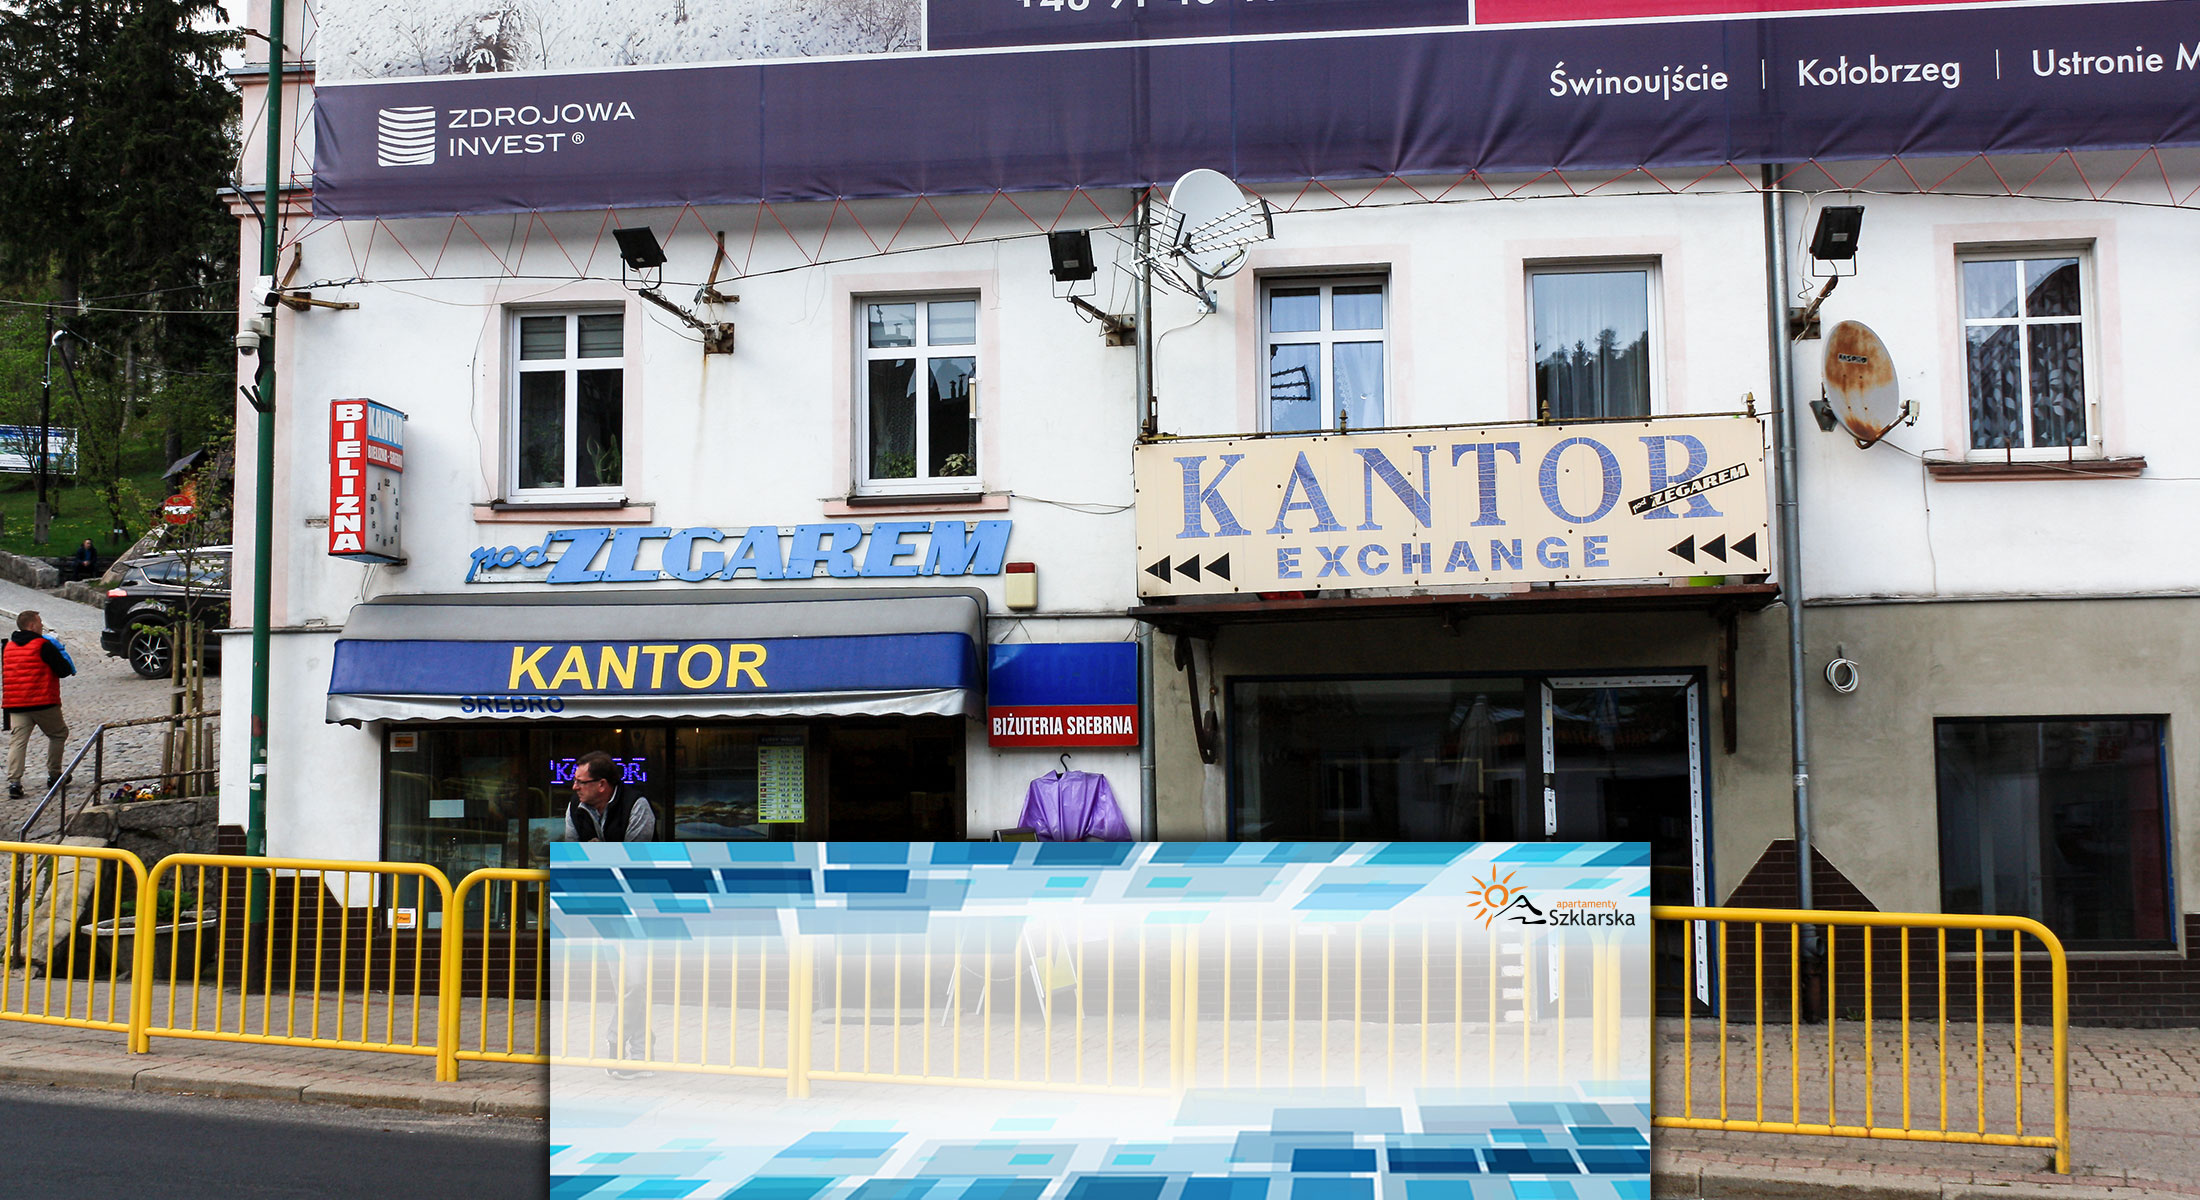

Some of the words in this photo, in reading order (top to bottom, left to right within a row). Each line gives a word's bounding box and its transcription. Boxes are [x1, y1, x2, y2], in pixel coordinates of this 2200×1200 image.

[1549, 61, 1729, 101] Świnoujście
[1798, 54, 1961, 89] Kołobrzeg
[2032, 46, 2164, 77] Ustronie
[448, 101, 636, 129] ZDROJOWA
[449, 132, 566, 157] INVEST
[367, 406, 403, 446] KANTOR
[332, 403, 364, 551] BIELIZNA
[1173, 434, 1724, 540] KANTOR
[1651, 464, 1746, 507] ZEGAREM
[464, 531, 554, 583] pod
[546, 519, 1012, 583] ZEGAREM
[1276, 535, 1609, 580] EXCHANGE
[509, 643, 768, 690] KANTOR
[460, 695, 565, 713] SREBRO
[993, 713, 1064, 736] BIŻUTERIA
[1067, 715, 1134, 736] SREBRNA
